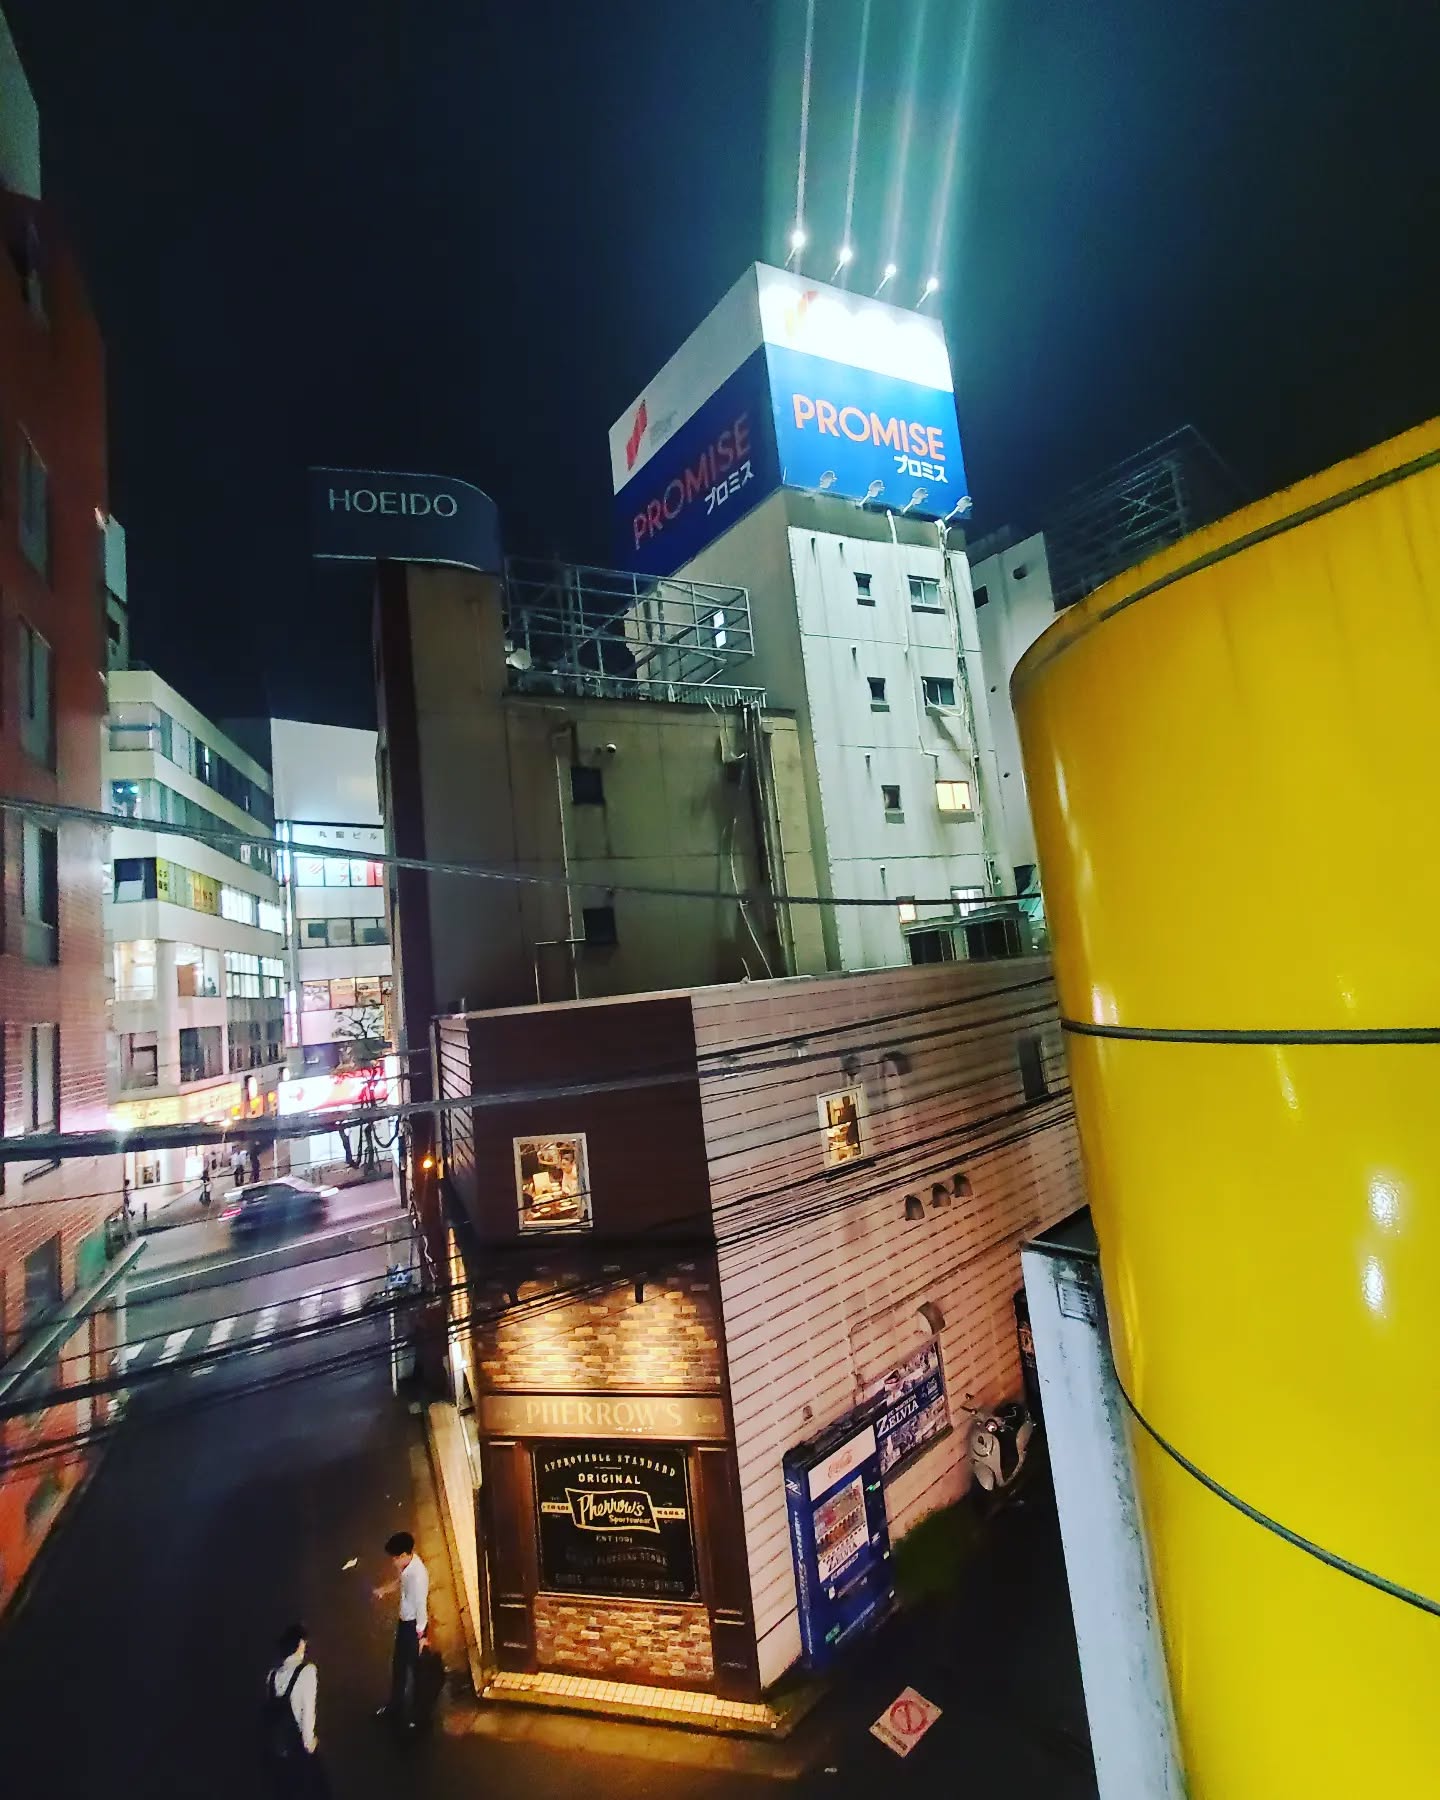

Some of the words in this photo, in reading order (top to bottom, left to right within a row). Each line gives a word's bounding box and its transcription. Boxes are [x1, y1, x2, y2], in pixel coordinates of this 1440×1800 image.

[792, 393, 946, 461] PROMISE
[632, 414, 752, 550] PROMISE
[893, 453, 948, 484] プロミス
[328, 488, 458, 517] HOEIDO
[703, 460, 755, 516] プロミス
[876, 1399, 920, 1439] ZELVIA
[578, 1473, 641, 1485] ORIGINAL
[617, 1454, 677, 1478] STANDARD
[576, 1492, 645, 1528] Pherrow's
[608, 1513, 652, 1525] Sportswear
